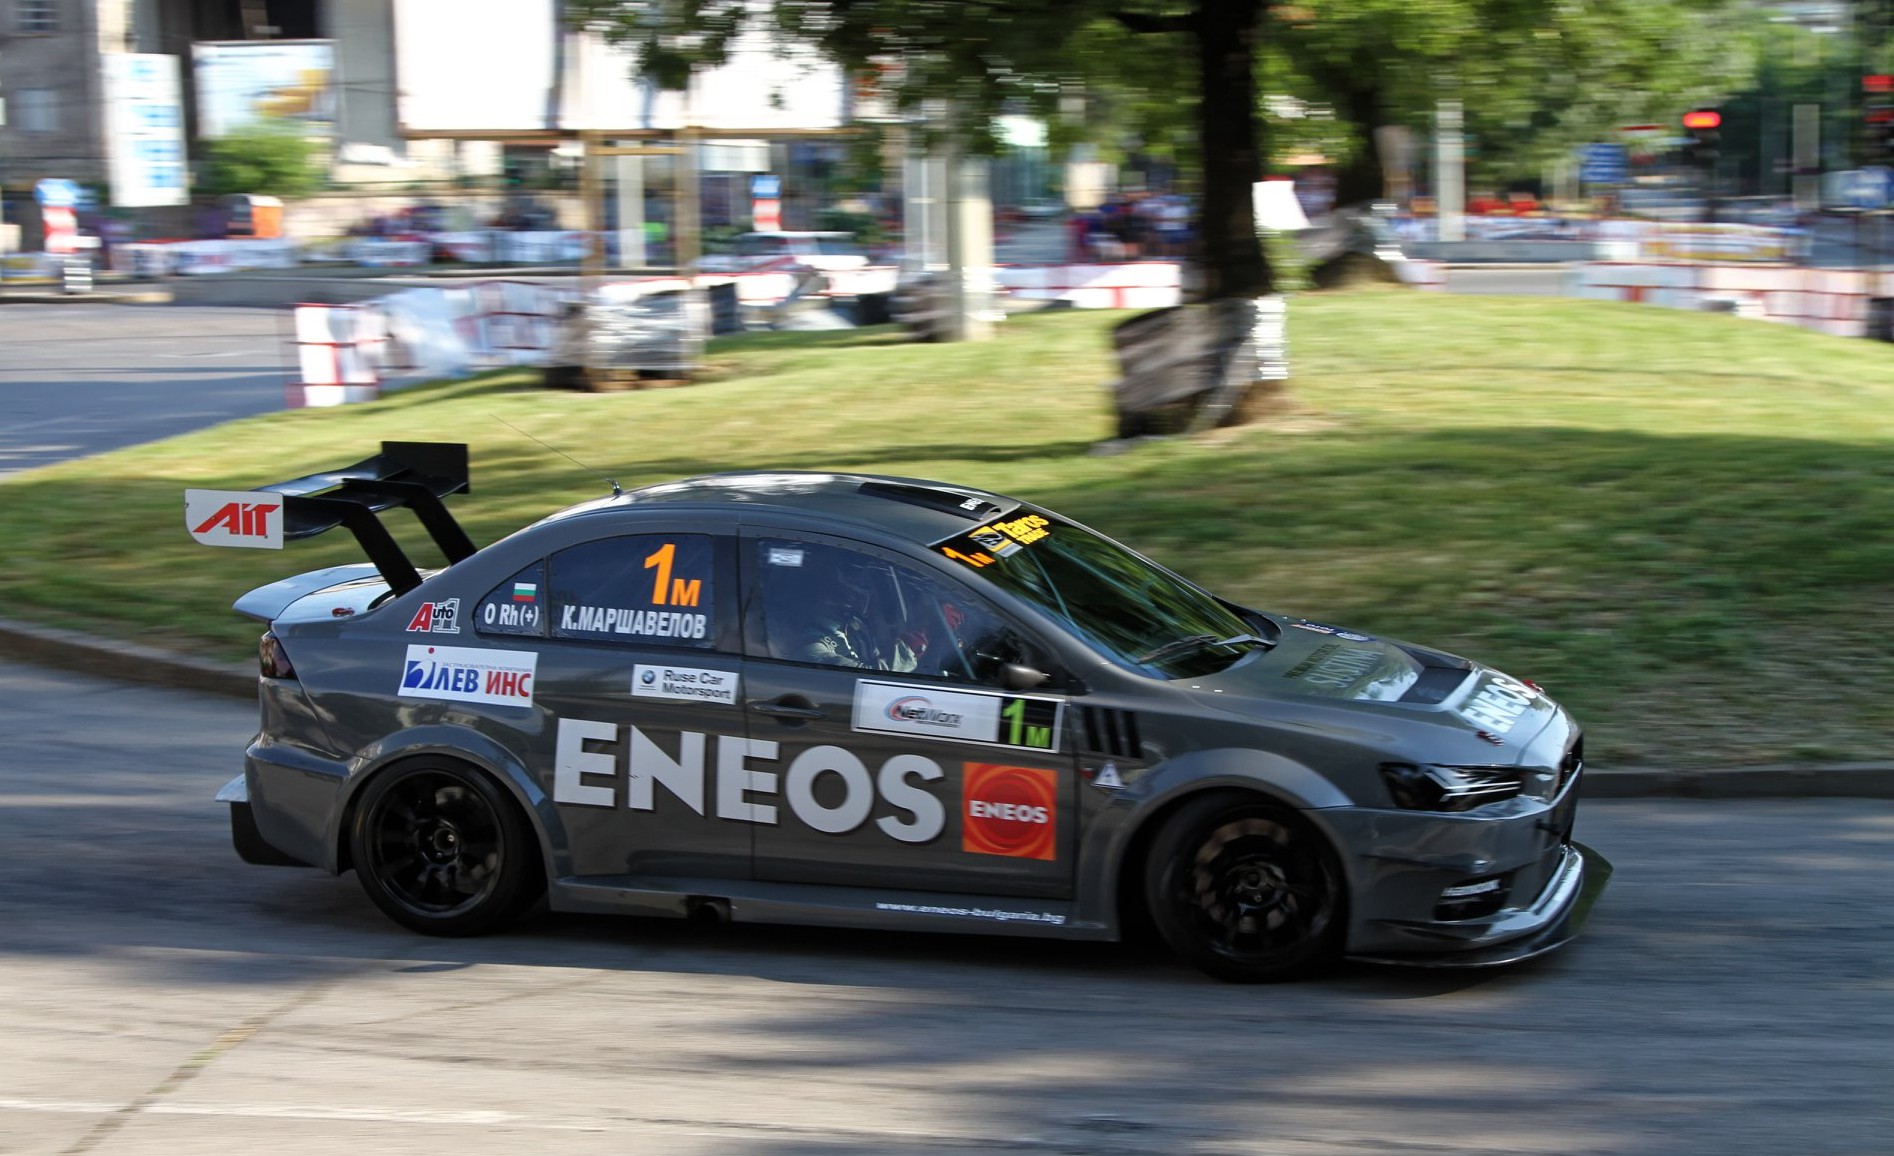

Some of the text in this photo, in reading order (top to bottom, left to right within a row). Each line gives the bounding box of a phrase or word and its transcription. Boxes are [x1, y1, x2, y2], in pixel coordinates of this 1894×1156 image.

[499, 603, 540, 627] Rh(+)
[561, 604, 707, 639] К.МАРШАВЕЛОВ
[433, 666, 532, 698] ЛЕВ ИНС
[663, 669, 724, 685] Ruse Car
[661, 682, 731, 699] Motorsport
[1459, 677, 1537, 734] ENEOS
[554, 717, 946, 843] ENEOS
[969, 799, 1049, 824] ENEOS
[876, 902, 1066, 925] www.eneos-bulgaria.bg
